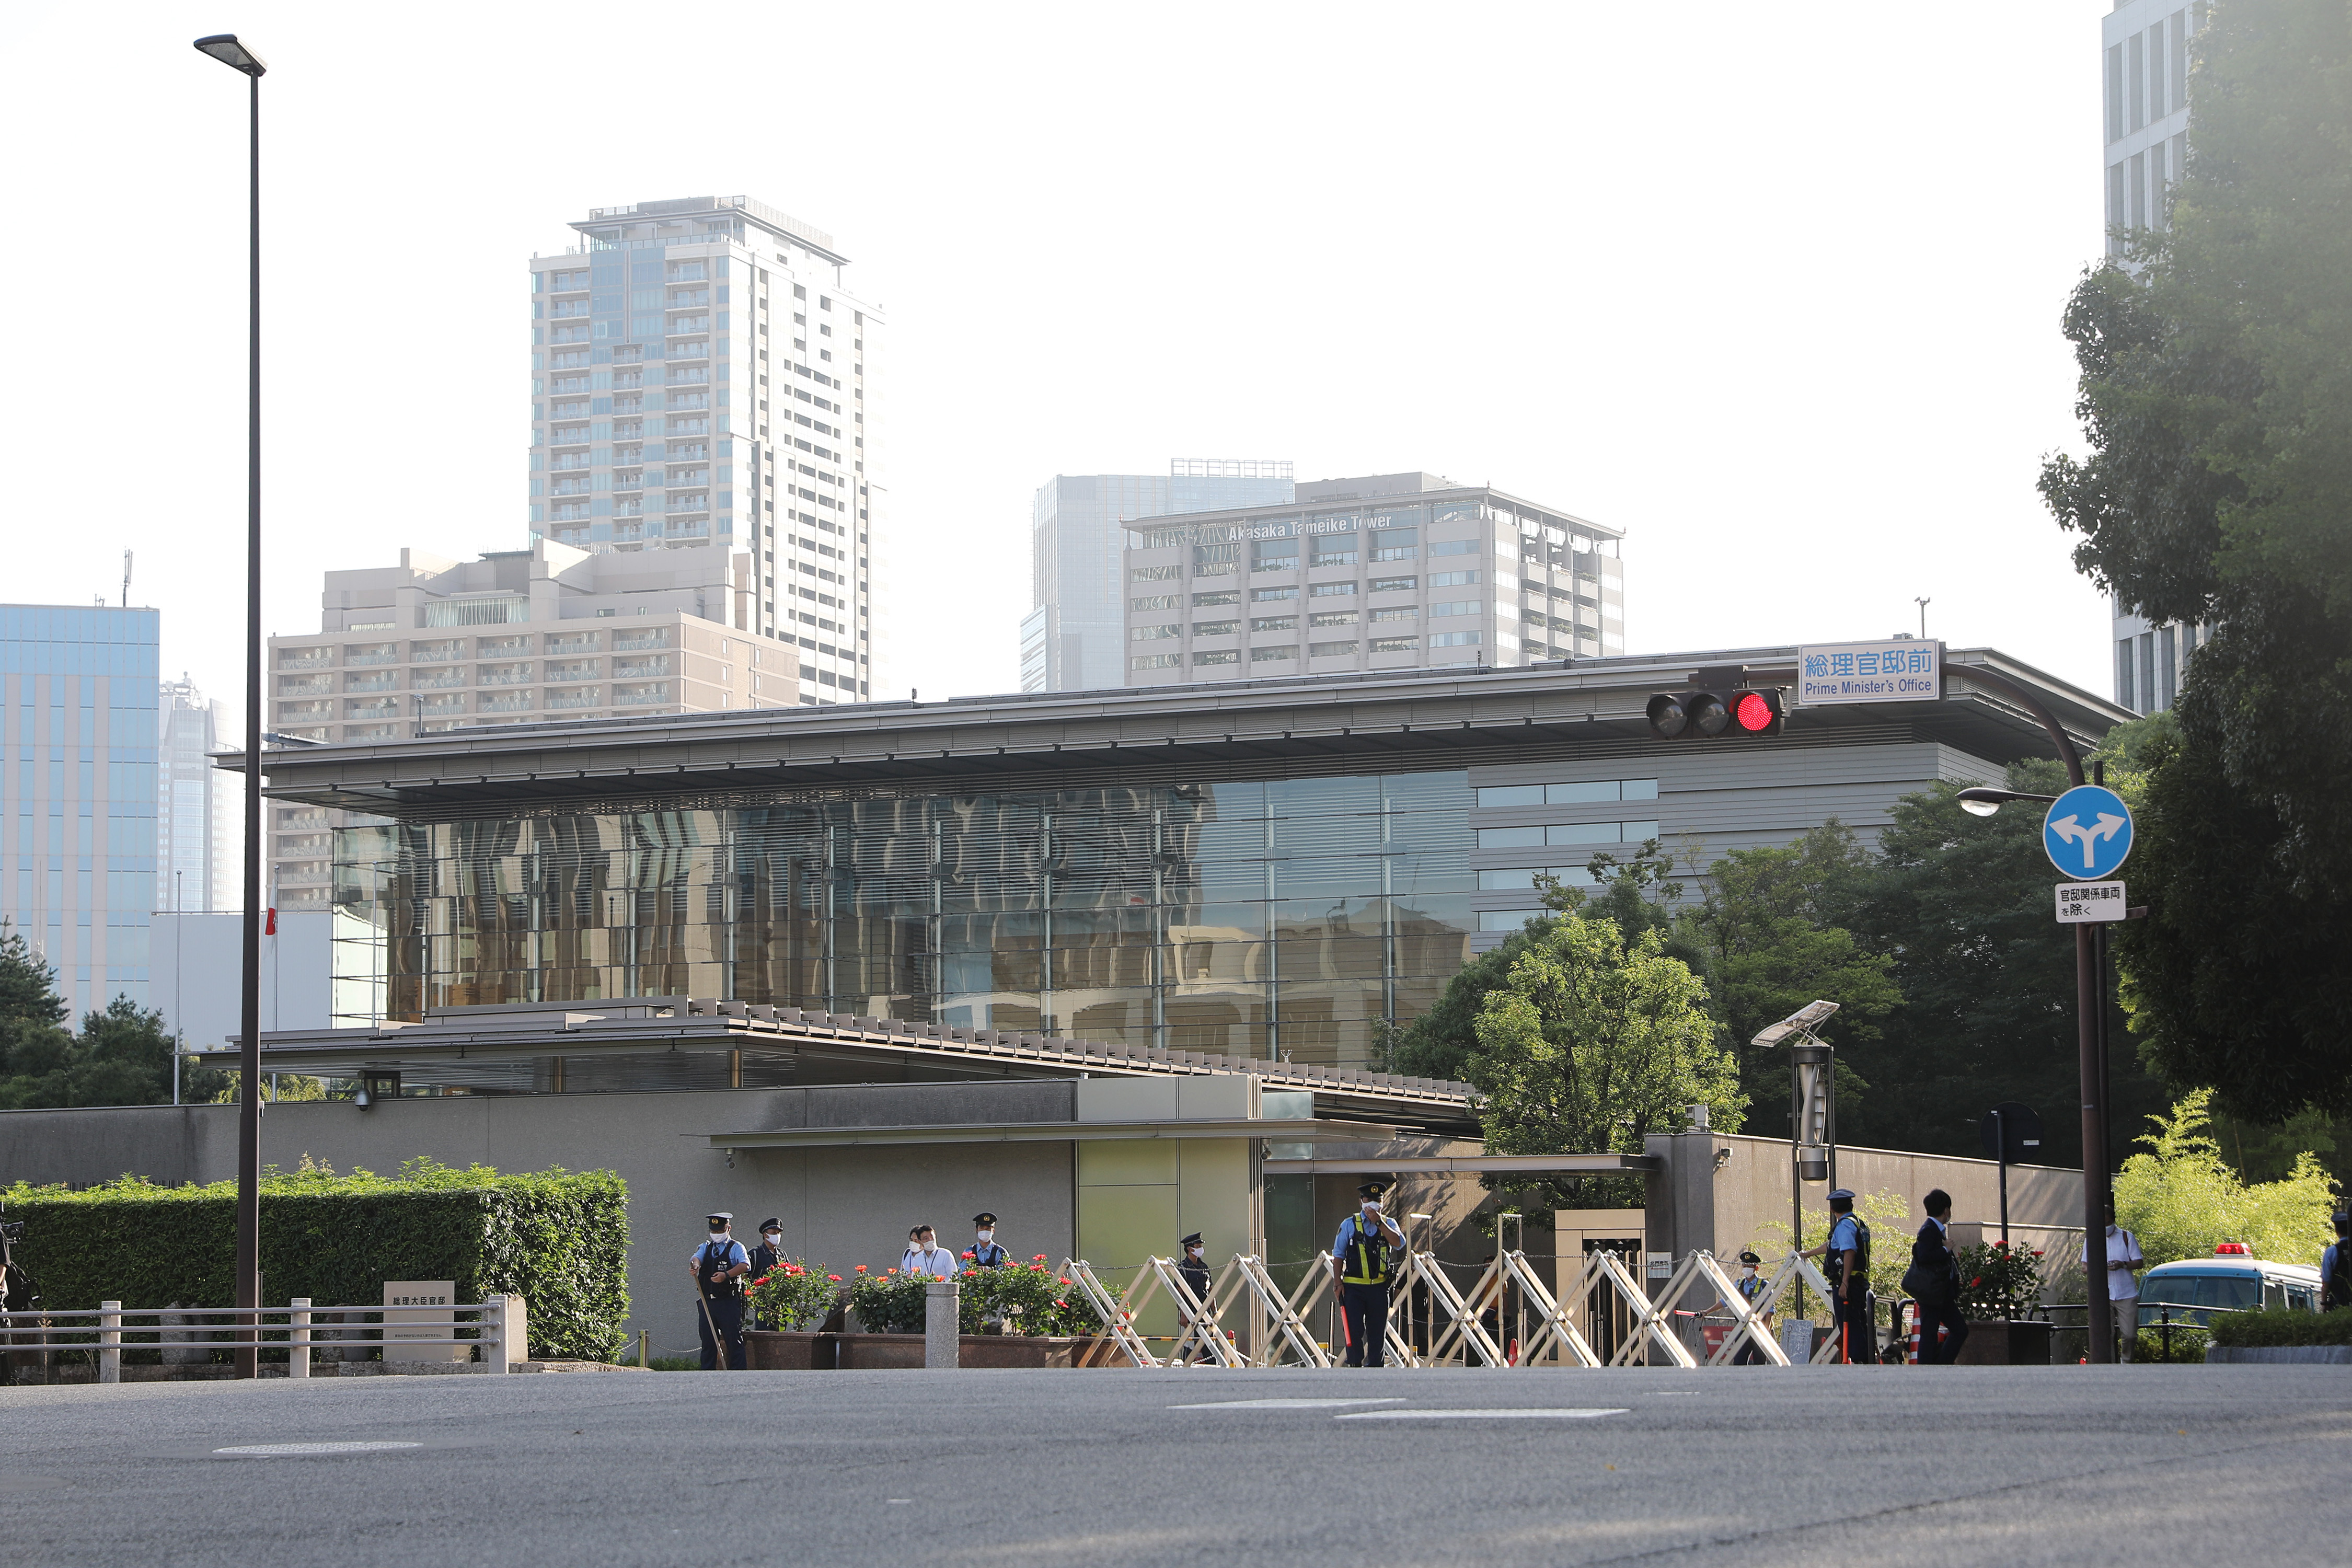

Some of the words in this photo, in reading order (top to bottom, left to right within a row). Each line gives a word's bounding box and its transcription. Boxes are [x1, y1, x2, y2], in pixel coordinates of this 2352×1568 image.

[1229, 523, 1285, 541] Akasaka
[1290, 517, 1347, 535] Tameike
[1805, 648, 1932, 677] 総理官邸前
[1805, 682, 1837, 695] Prime
[1841, 679, 1894, 694] Minister's
[1898, 678, 1931, 691] Office
[2060, 886, 2120, 902] 官邸関係車両
[2061, 903, 2091, 916] を除く
[393, 1296, 445, 1305] 総理大臣官邸
